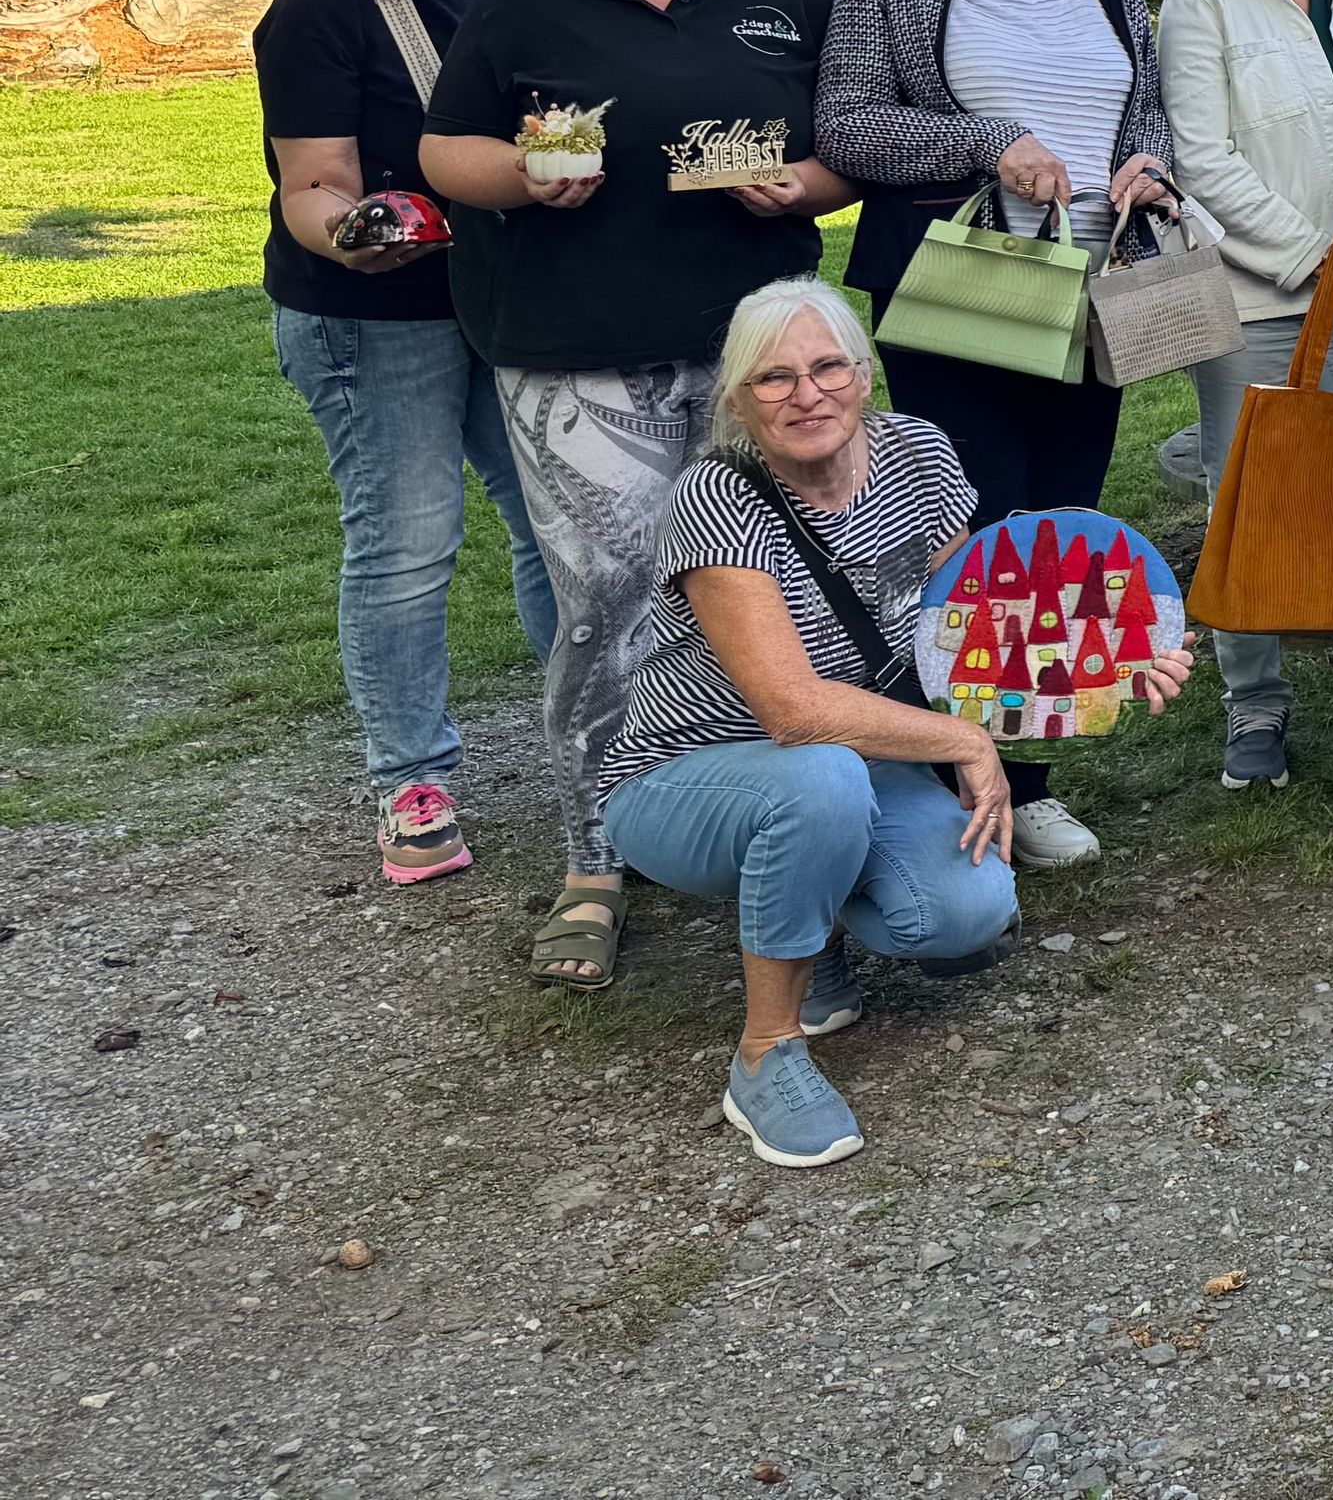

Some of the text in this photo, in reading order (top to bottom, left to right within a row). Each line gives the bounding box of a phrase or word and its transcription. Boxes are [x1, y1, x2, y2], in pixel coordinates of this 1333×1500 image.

[732, 25, 802, 41] Geschenk
[742, 19, 788, 33] Idee &
[682, 119, 758, 149] Hallo
[703, 140, 785, 172] HERBST
